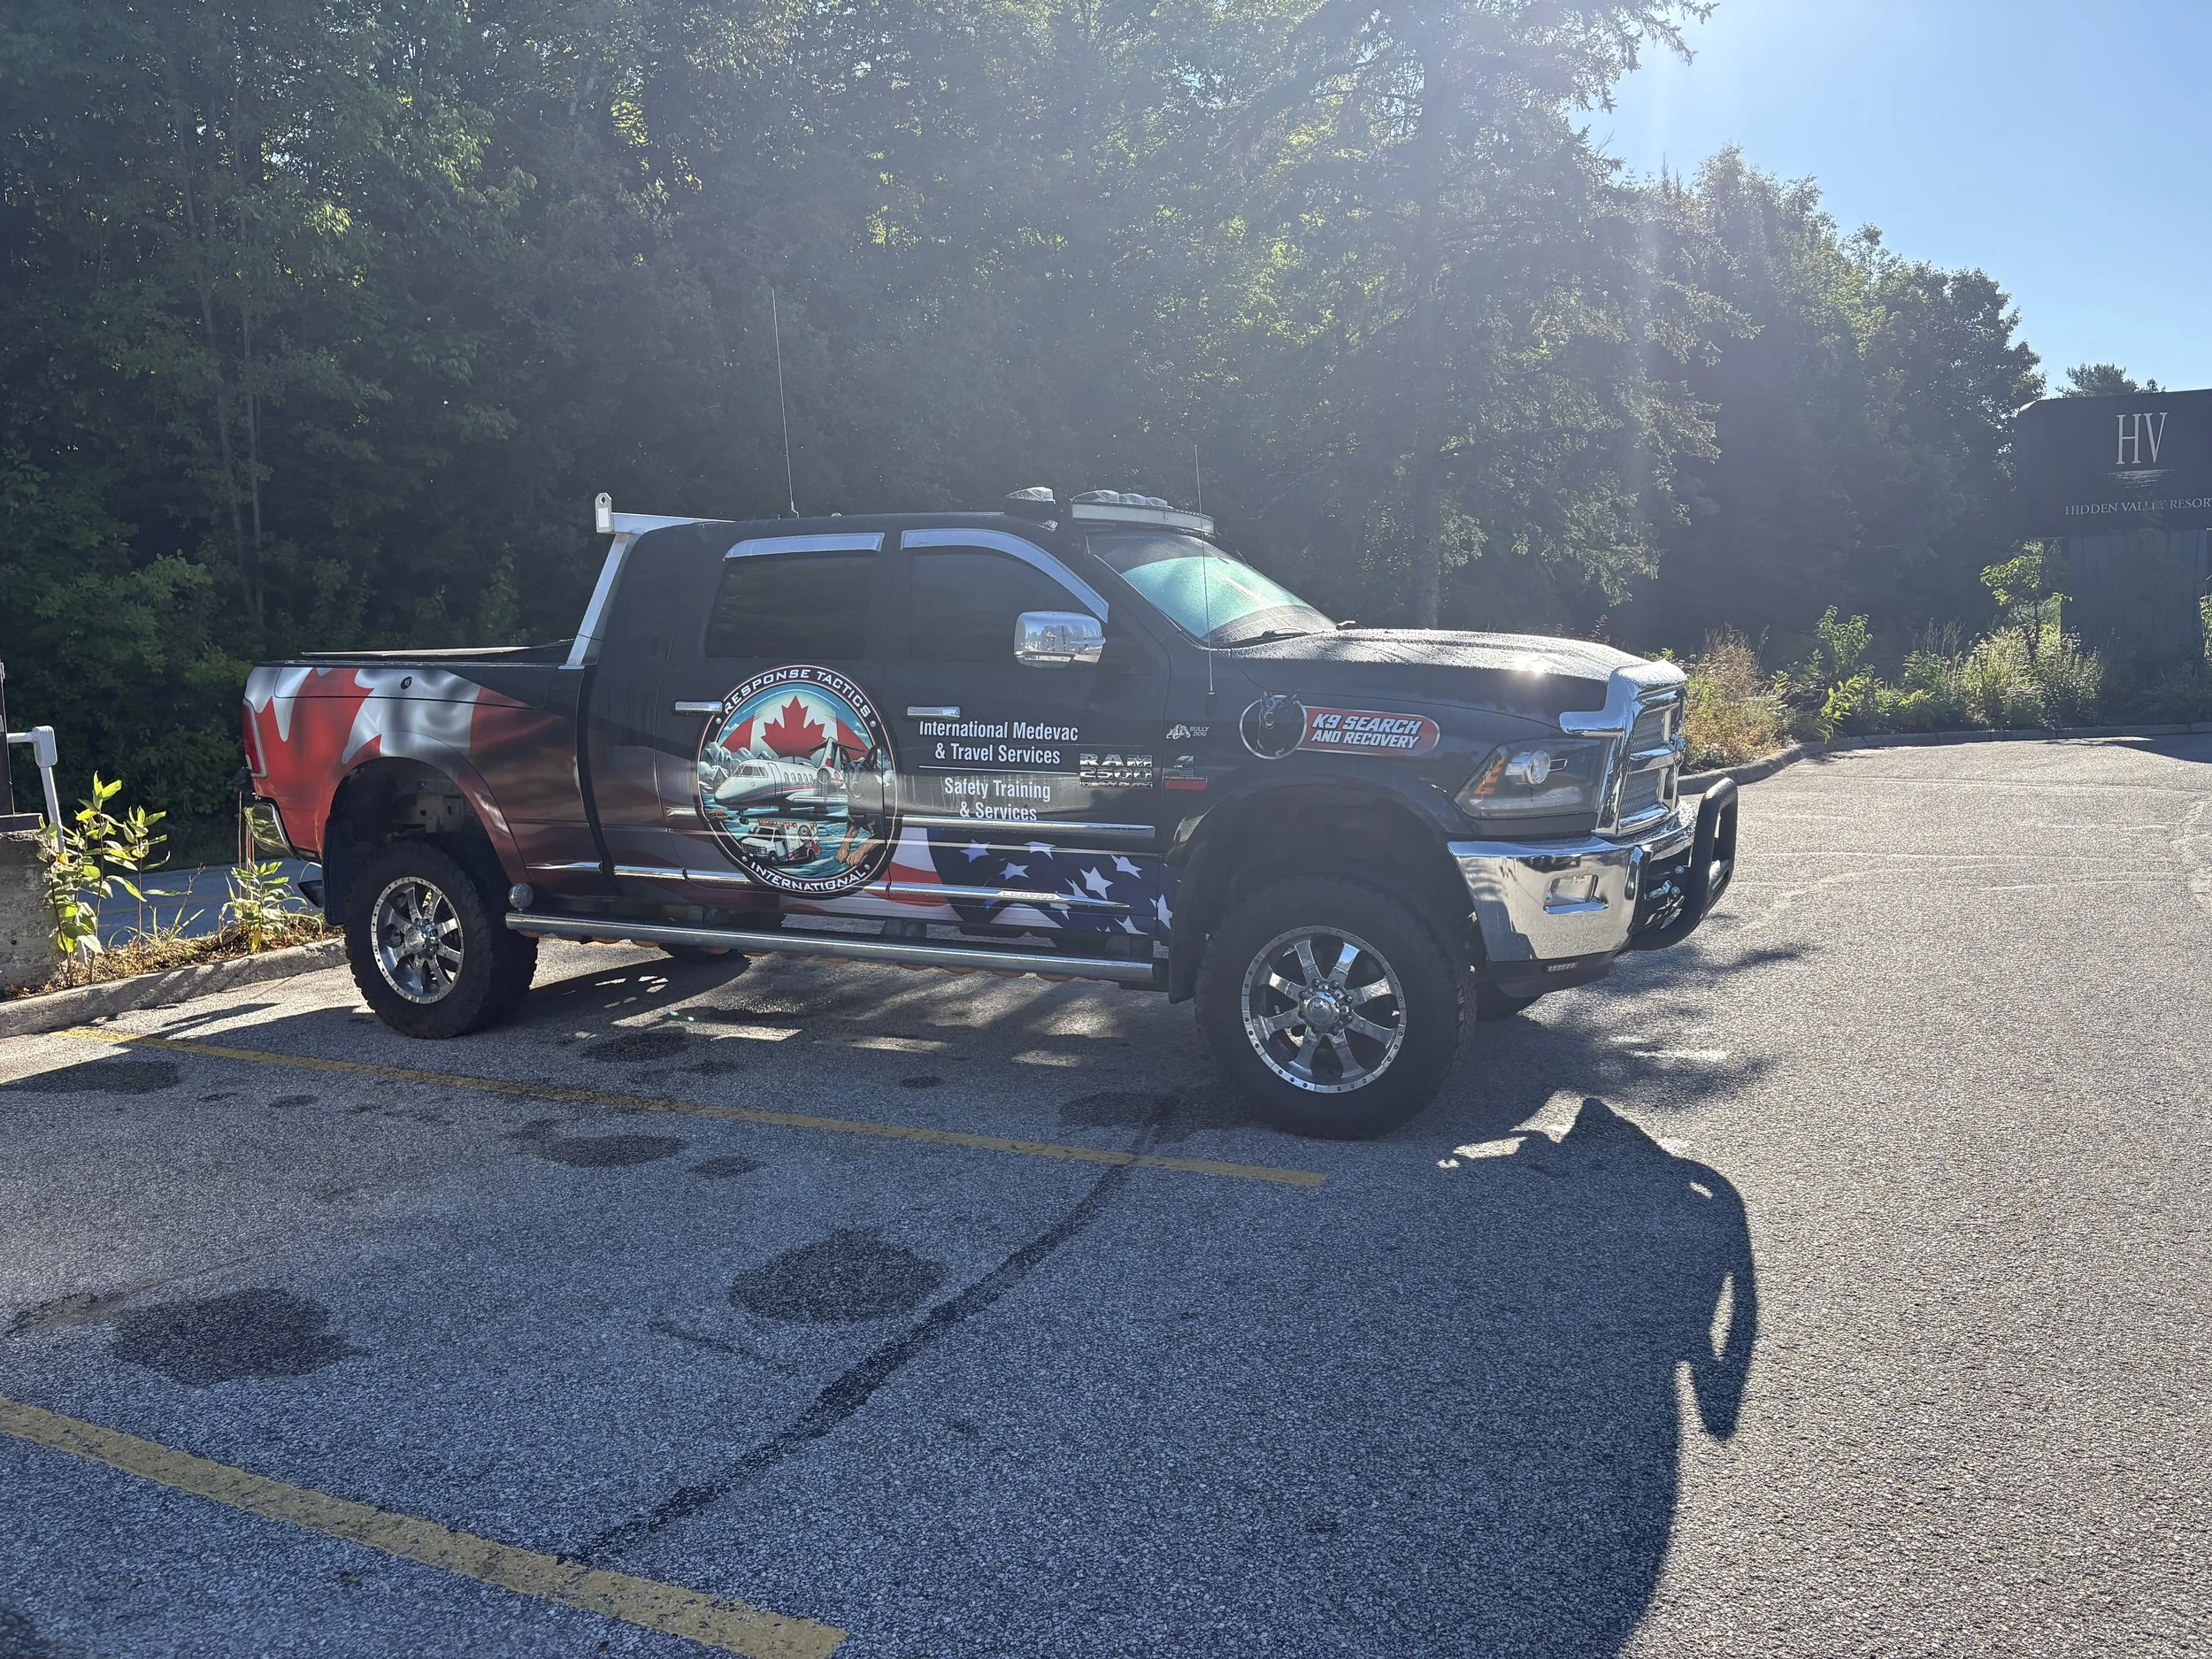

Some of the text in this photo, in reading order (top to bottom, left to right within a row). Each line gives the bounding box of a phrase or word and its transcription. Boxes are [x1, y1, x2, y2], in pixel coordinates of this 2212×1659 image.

[2116, 411, 2168, 465] HV
[2065, 502, 2118, 516] HIDDEN
[725, 669, 872, 718] RESPONSE TACTICS
[919, 720, 1079, 741] International Medevac
[1311, 713, 1423, 734] K9 SEARCH
[1310, 729, 1421, 749] AND RECOVERY
[935, 742, 1061, 764] & Travel Services
[1079, 753, 1153, 768] RAM
[1079, 766, 1153, 781] 2500
[944, 777, 1051, 803] Safety Training
[959, 801, 1038, 821] & Services
[750, 861, 866, 892] INTERNATIONAL
[1002, 891, 1056, 900] LIMITED
